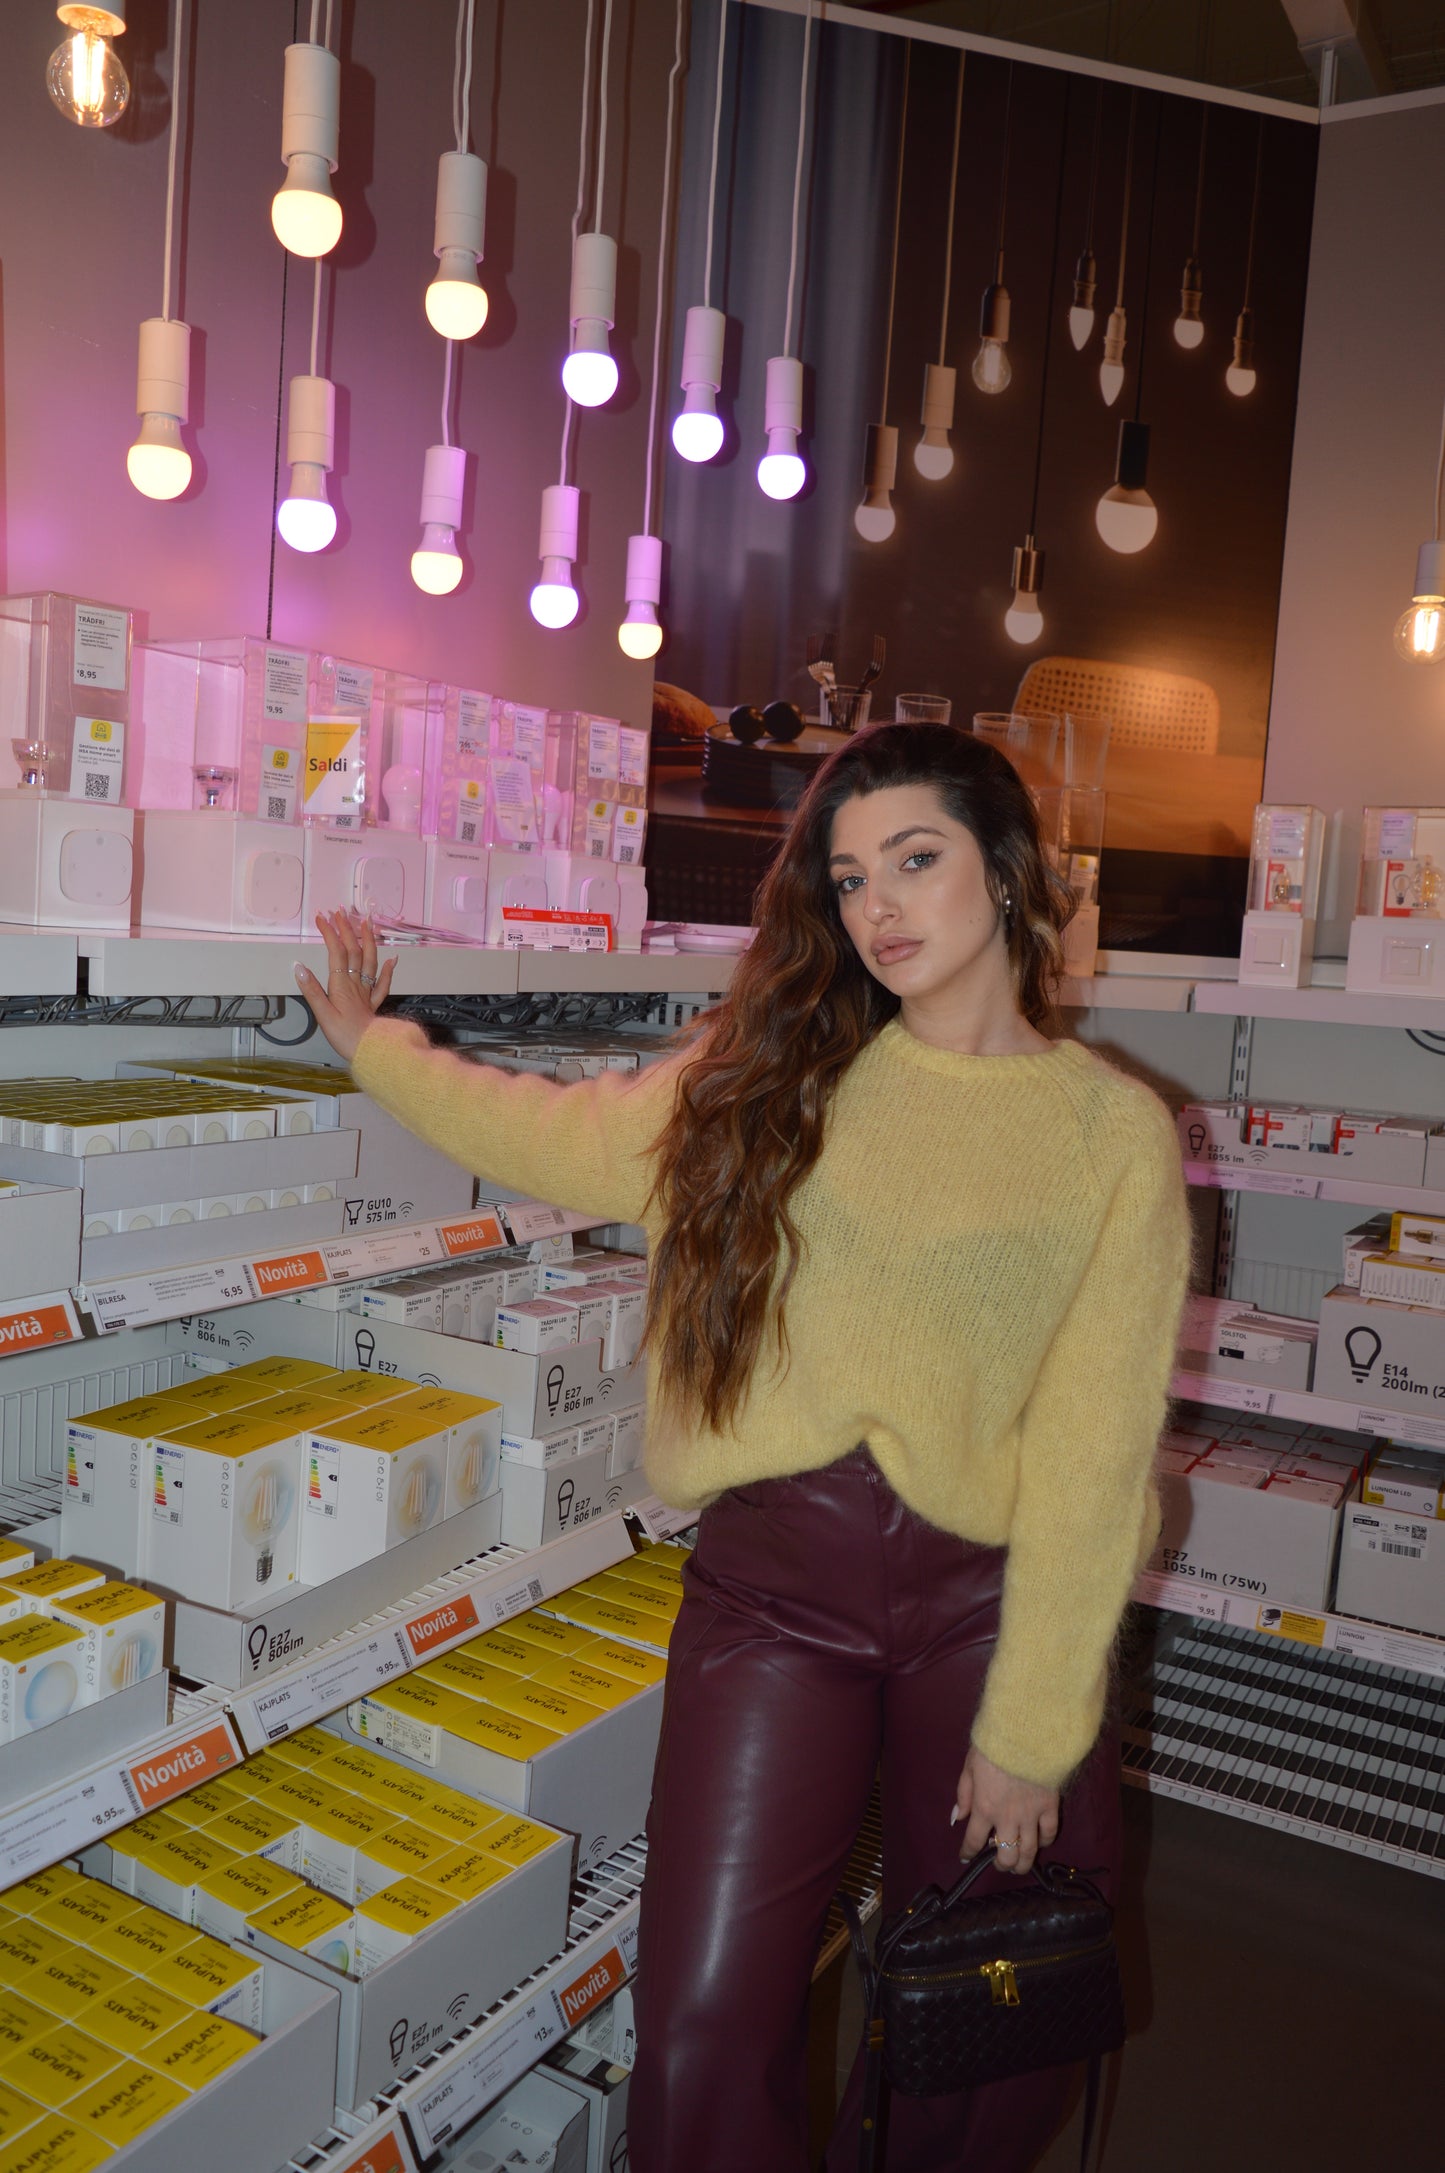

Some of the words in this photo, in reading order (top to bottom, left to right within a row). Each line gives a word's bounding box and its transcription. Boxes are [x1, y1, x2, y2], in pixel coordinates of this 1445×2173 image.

[309, 758, 348, 772] Saldi
[1208, 1144, 1224, 1152] E27
[1208, 1153, 1230, 1162] 1055
[1233, 1154, 1244, 1163] lm
[368, 1198, 392, 1211] GU10
[366, 1211, 382, 1224] 575
[384, 1210, 396, 1222] lm
[446, 1225, 484, 1246] Novità
[258, 1260, 308, 1284] Novità
[97, 1294, 126, 1306] BILRESA
[220, 1285, 244, 1298] €6,95
[198, 1318, 216, 1332] E27
[197, 1330, 216, 1343] 806
[218, 1335, 230, 1348] lm
[378, 1360, 398, 1374] E27
[1384, 1364, 1408, 1378] E14
[566, 1386, 582, 1400] E27
[1382, 1376, 1428, 1395] 200lm
[564, 1399, 580, 1413] 806
[583, 1396, 594, 1406] lm
[1372, 1485, 1400, 1494] LUNNOM
[574, 1510, 589, 1524] 806
[592, 1506, 602, 1517] lm
[575, 1498, 591, 1512] E27
[1162, 1548, 1188, 1562] E27
[16, 1564, 74, 1586] KAJPLATS
[1162, 1560, 1196, 1576] 1055
[1200, 1568, 1218, 1582] lm
[1222, 1573, 1268, 1595] (75W)
[75, 1587, 134, 1610] KAJPLATS
[410, 1606, 458, 1642] Novità
[268, 1636, 304, 1662] 806lm
[270, 1630, 290, 1650] E27
[442, 1663, 485, 1681] KAJPLATS
[570, 1670, 612, 1688] KAJPLATS
[258, 1692, 291, 1712] KAJPLATS
[395, 1686, 438, 1707] KAJPLATS
[524, 1695, 568, 1716] KAJPLATS
[476, 1719, 522, 1740] KAJPLATS
[138, 1744, 206, 1792] Novità
[332, 1756, 375, 1778] KAJPLATS
[278, 1784, 324, 1807] KAJPLATS
[380, 1778, 424, 1802] KAJPLATS
[224, 1815, 270, 1839] KAJPLATS
[328, 1808, 374, 1833] KAJPLATS
[432, 1804, 478, 1828] KAJPLATS
[382, 1834, 428, 1860] KAJPLATS
[488, 1824, 530, 1851] KAJPLATS
[165, 1842, 210, 1870] KAJPLATS
[438, 1855, 483, 1884] KAJPLATS
[224, 1869, 270, 1896] KAJPLATS
[59, 1897, 108, 1924] KAJPLATS
[270, 1896, 323, 1926] KAJPLATS
[380, 1892, 431, 1919] KAJPLATS
[114, 1925, 166, 1954] KAJPLATS
[44, 1966, 98, 1997] KAJPLATS
[172, 1956, 227, 1987] KAJPLATS
[564, 1965, 610, 2015] Novità
[104, 2000, 159, 2032] KAJPLATS
[411, 2032, 432, 2054] 1521
[432, 2024, 444, 2039] lm
[412, 2022, 428, 2041] E27
[163, 2022, 223, 2066] KAJPLATS
[28, 2048, 86, 2082] KAJPLATS
[90, 2074, 155, 2120] KAJPLATS
[423, 2084, 454, 2114] KAJPLATS
